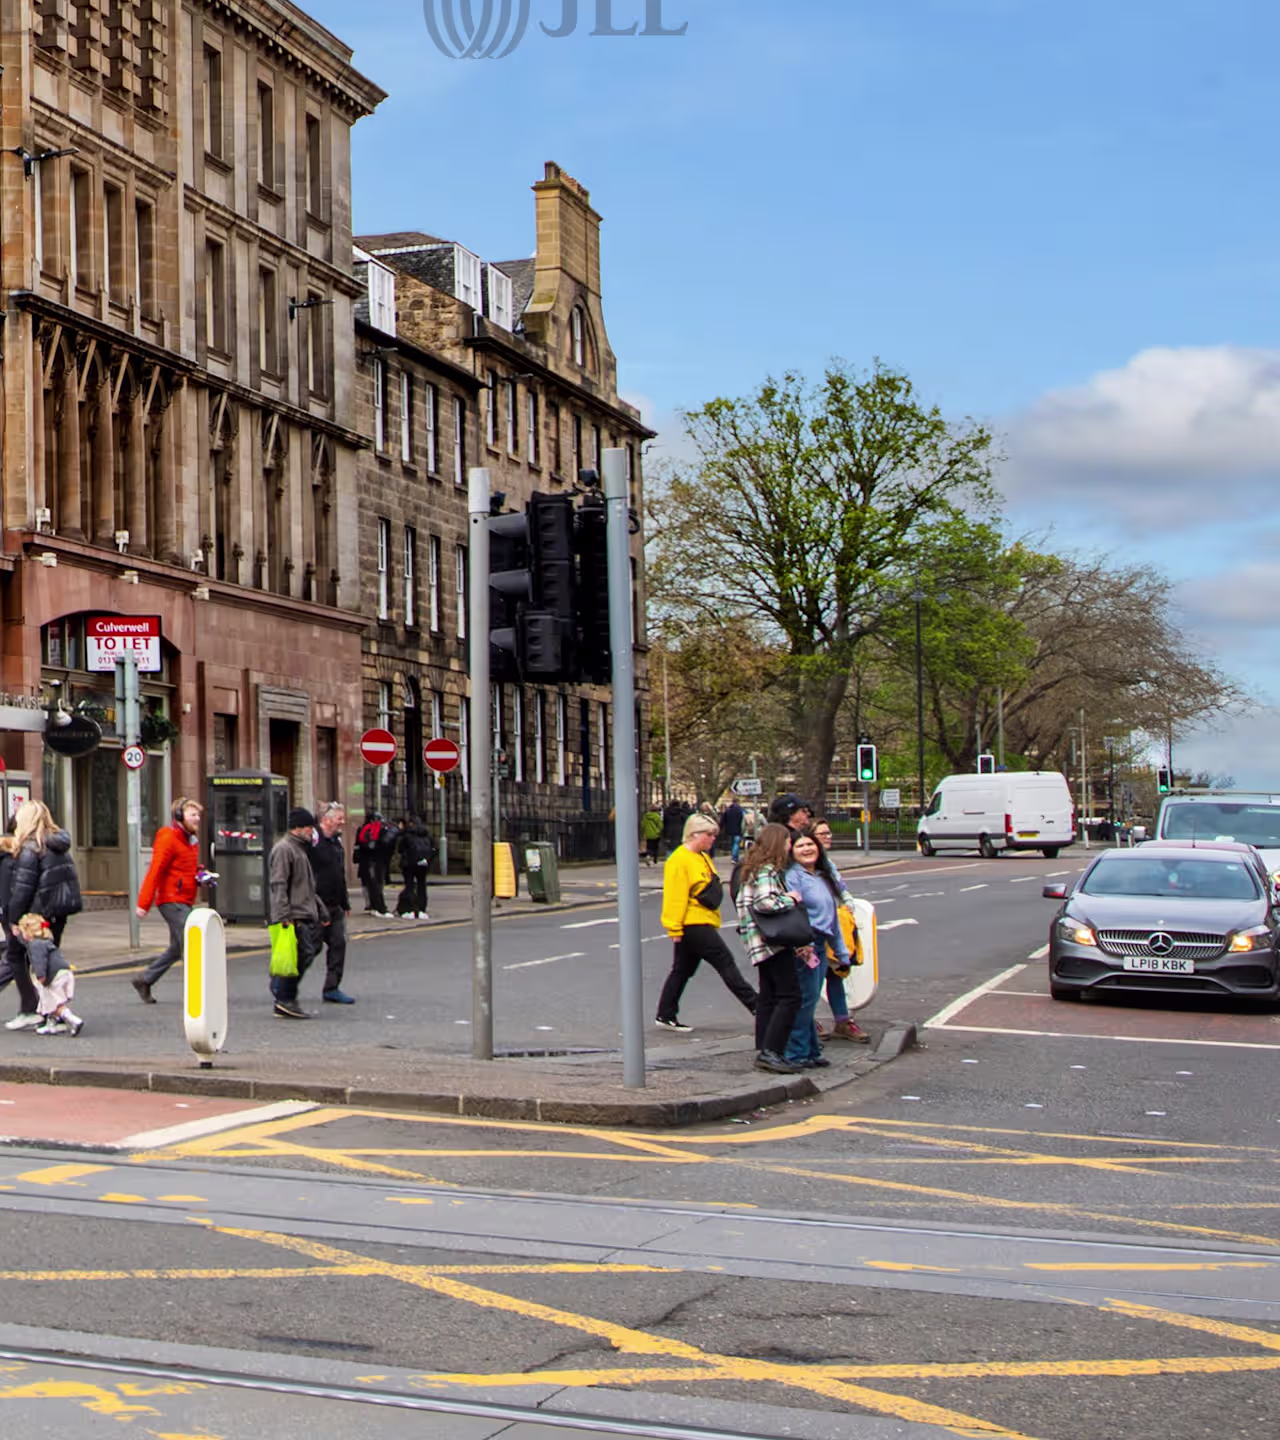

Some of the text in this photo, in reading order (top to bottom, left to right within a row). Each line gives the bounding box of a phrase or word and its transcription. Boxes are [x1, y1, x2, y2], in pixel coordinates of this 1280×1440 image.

[95, 621, 150, 632] Culverwell
[94, 637, 117, 650] TO
[126, 752, 141, 762] 20
[1131, 958, 1187, 971] LP18 KBK
